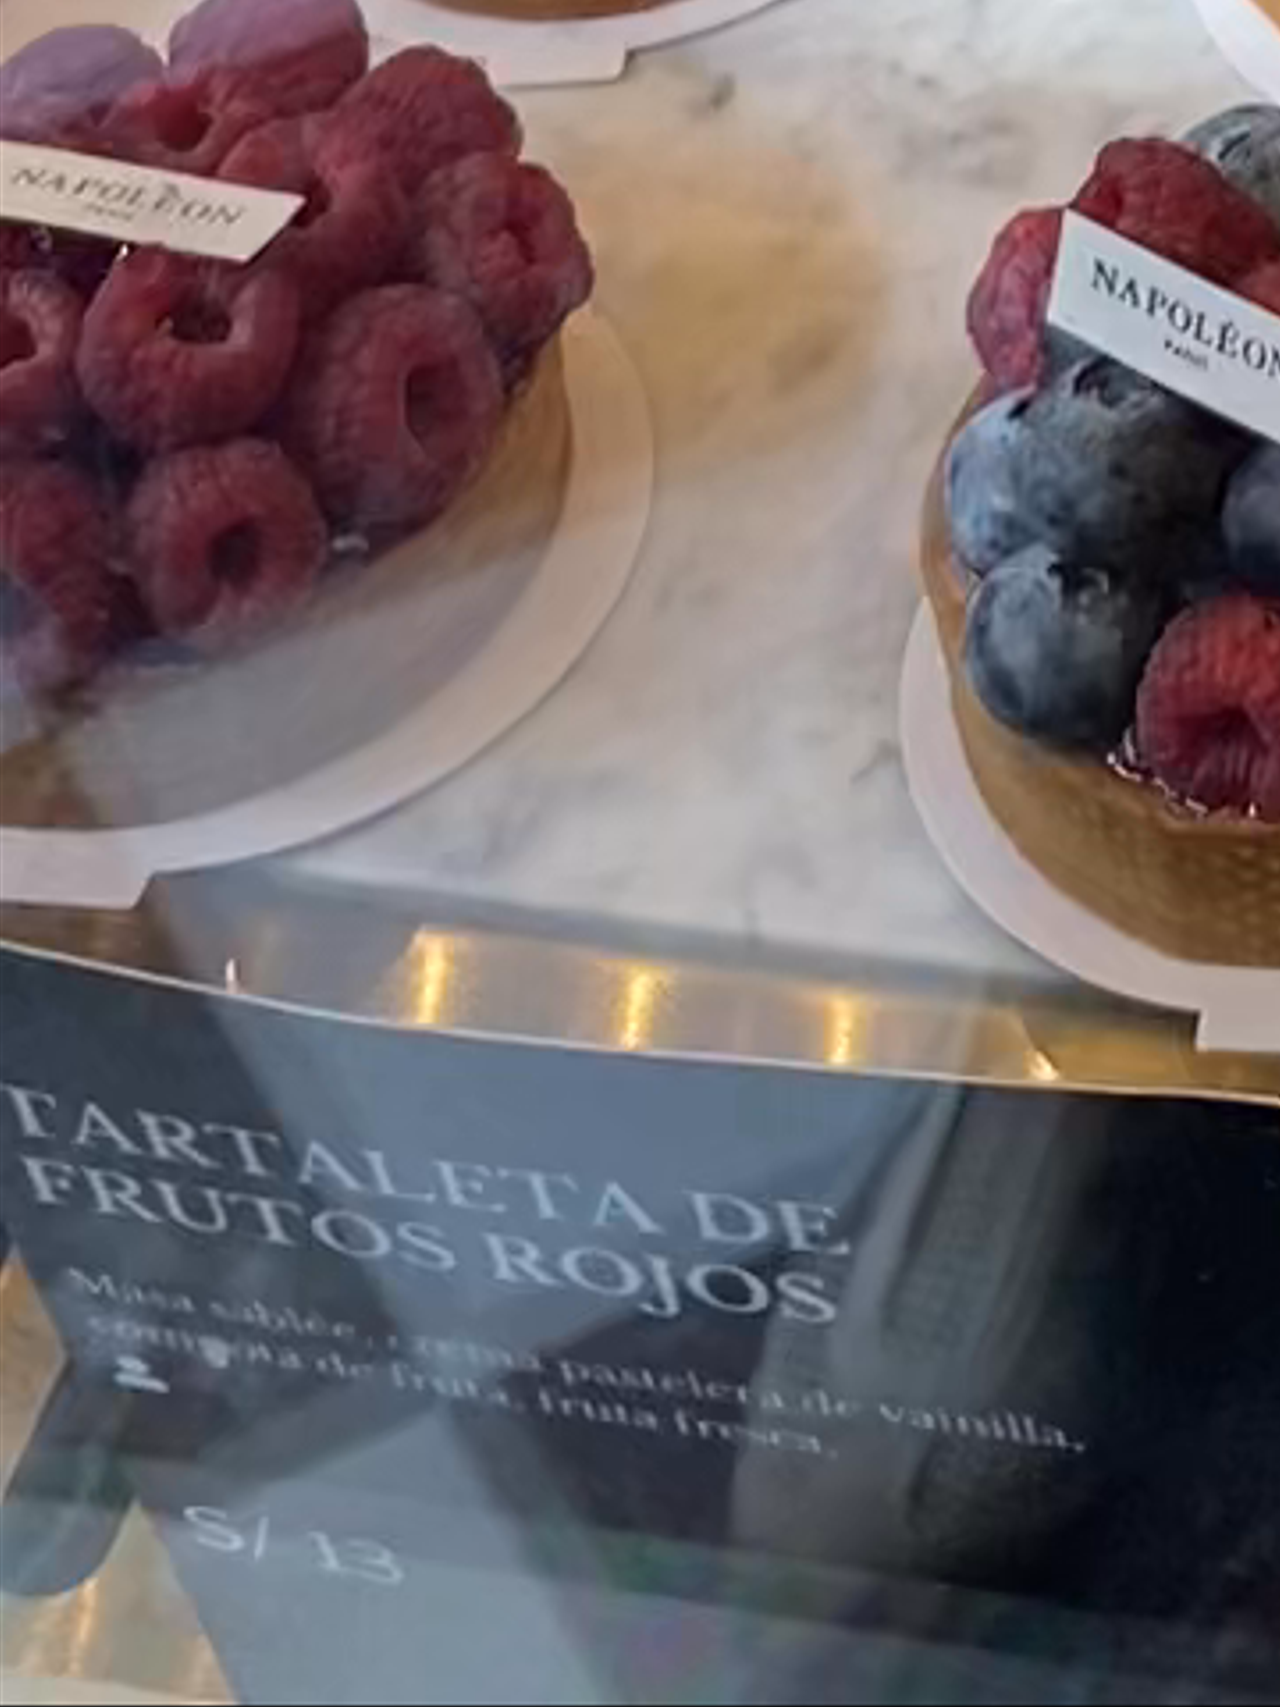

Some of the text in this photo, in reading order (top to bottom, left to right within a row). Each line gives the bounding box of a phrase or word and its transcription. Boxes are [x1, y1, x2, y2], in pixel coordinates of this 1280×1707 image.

[3, 1085, 850, 1256] TARTALETA DE
[22, 1155, 837, 1323] FRUTOS ROJOS
[183, 1505, 405, 1585] S/ 13
